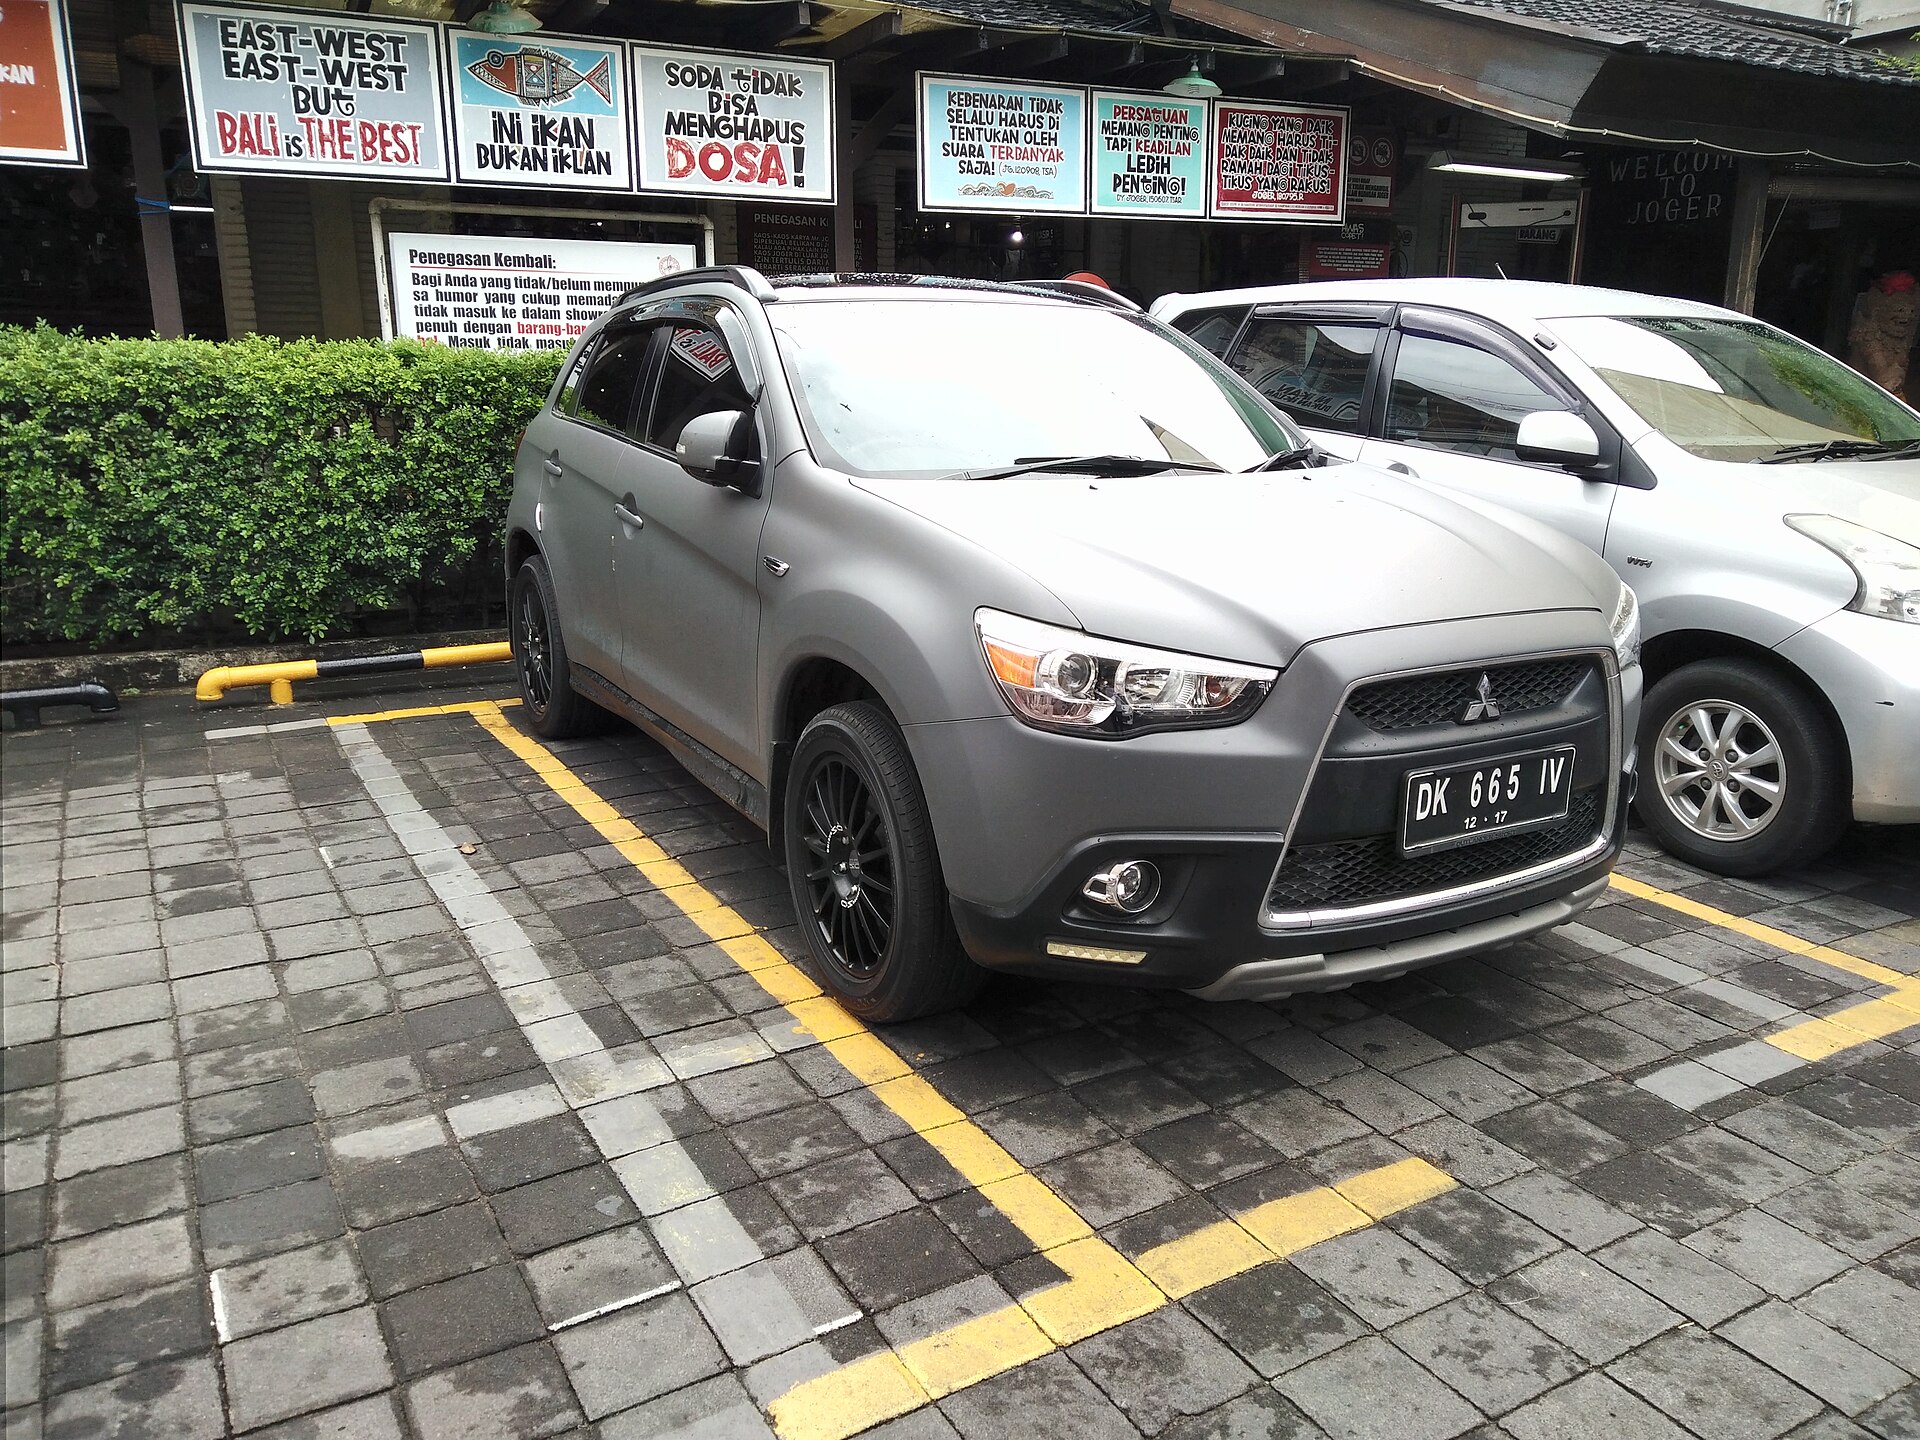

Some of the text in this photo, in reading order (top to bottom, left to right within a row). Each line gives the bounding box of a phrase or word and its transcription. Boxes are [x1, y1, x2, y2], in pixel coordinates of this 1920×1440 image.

[219, 19, 408, 64] EAST-WEST
[222, 50, 408, 91] EAST-WEST
[665, 62, 722, 90] SODA
[948, 91, 1023, 112] KEBENARAN
[665, 112, 805, 145] MENGHAPUS
[947, 108, 994, 125] SELALU
[999, 112, 1044, 130] HARUS
[1101, 120, 1150, 137] MEMANG
[1270, 116, 1303, 132] YANG
[299, 117, 355, 161] THE
[360, 123, 421, 166] BEST
[950, 125, 1057, 146] TENTUKAN OLEH
[1221, 128, 1274, 146] MEMANG
[1277, 131, 1317, 147] HARUS
[477, 144, 547, 172] BUKAN
[942, 142, 1064, 163] SUARA TERBANYAK
[1224, 144, 1246, 159] DAK
[1276, 147, 1298, 162] DAN
[666, 138, 805, 188] DOSA!
[959, 160, 995, 175] SAJA!
[1221, 159, 1263, 175] RAMAH
[1610, 151, 1734, 182] WELCOM
[1256, 176, 1288, 192] YANG
[1290, 176, 1330, 194] RAKUS!
[1660, 173, 1696, 199] TO
[1628, 194, 1721, 225] JOGER
[754, 213, 816, 227] PENEGASAN
[1519, 228, 1557, 240] BARANG
[409, 249, 557, 269] Penegasan Kembali:
[411, 272, 442, 288] Bagi
[445, 273, 478, 287] Anda
[480, 276, 511, 290] yang
[514, 275, 591, 291] tidak/belum
[413, 288, 618, 306] sa humor yang cukup memada
[414, 304, 448, 317] tidak
[453, 306, 497, 318] masuk
[502, 306, 517, 319] ke
[522, 306, 561, 320] dalam
[416, 320, 587, 336] penuh dengan barang-bar
[448, 335, 491, 349] Masuk
[497, 336, 529, 350] tidak
[1415, 756, 1565, 821] DK 665 IV
